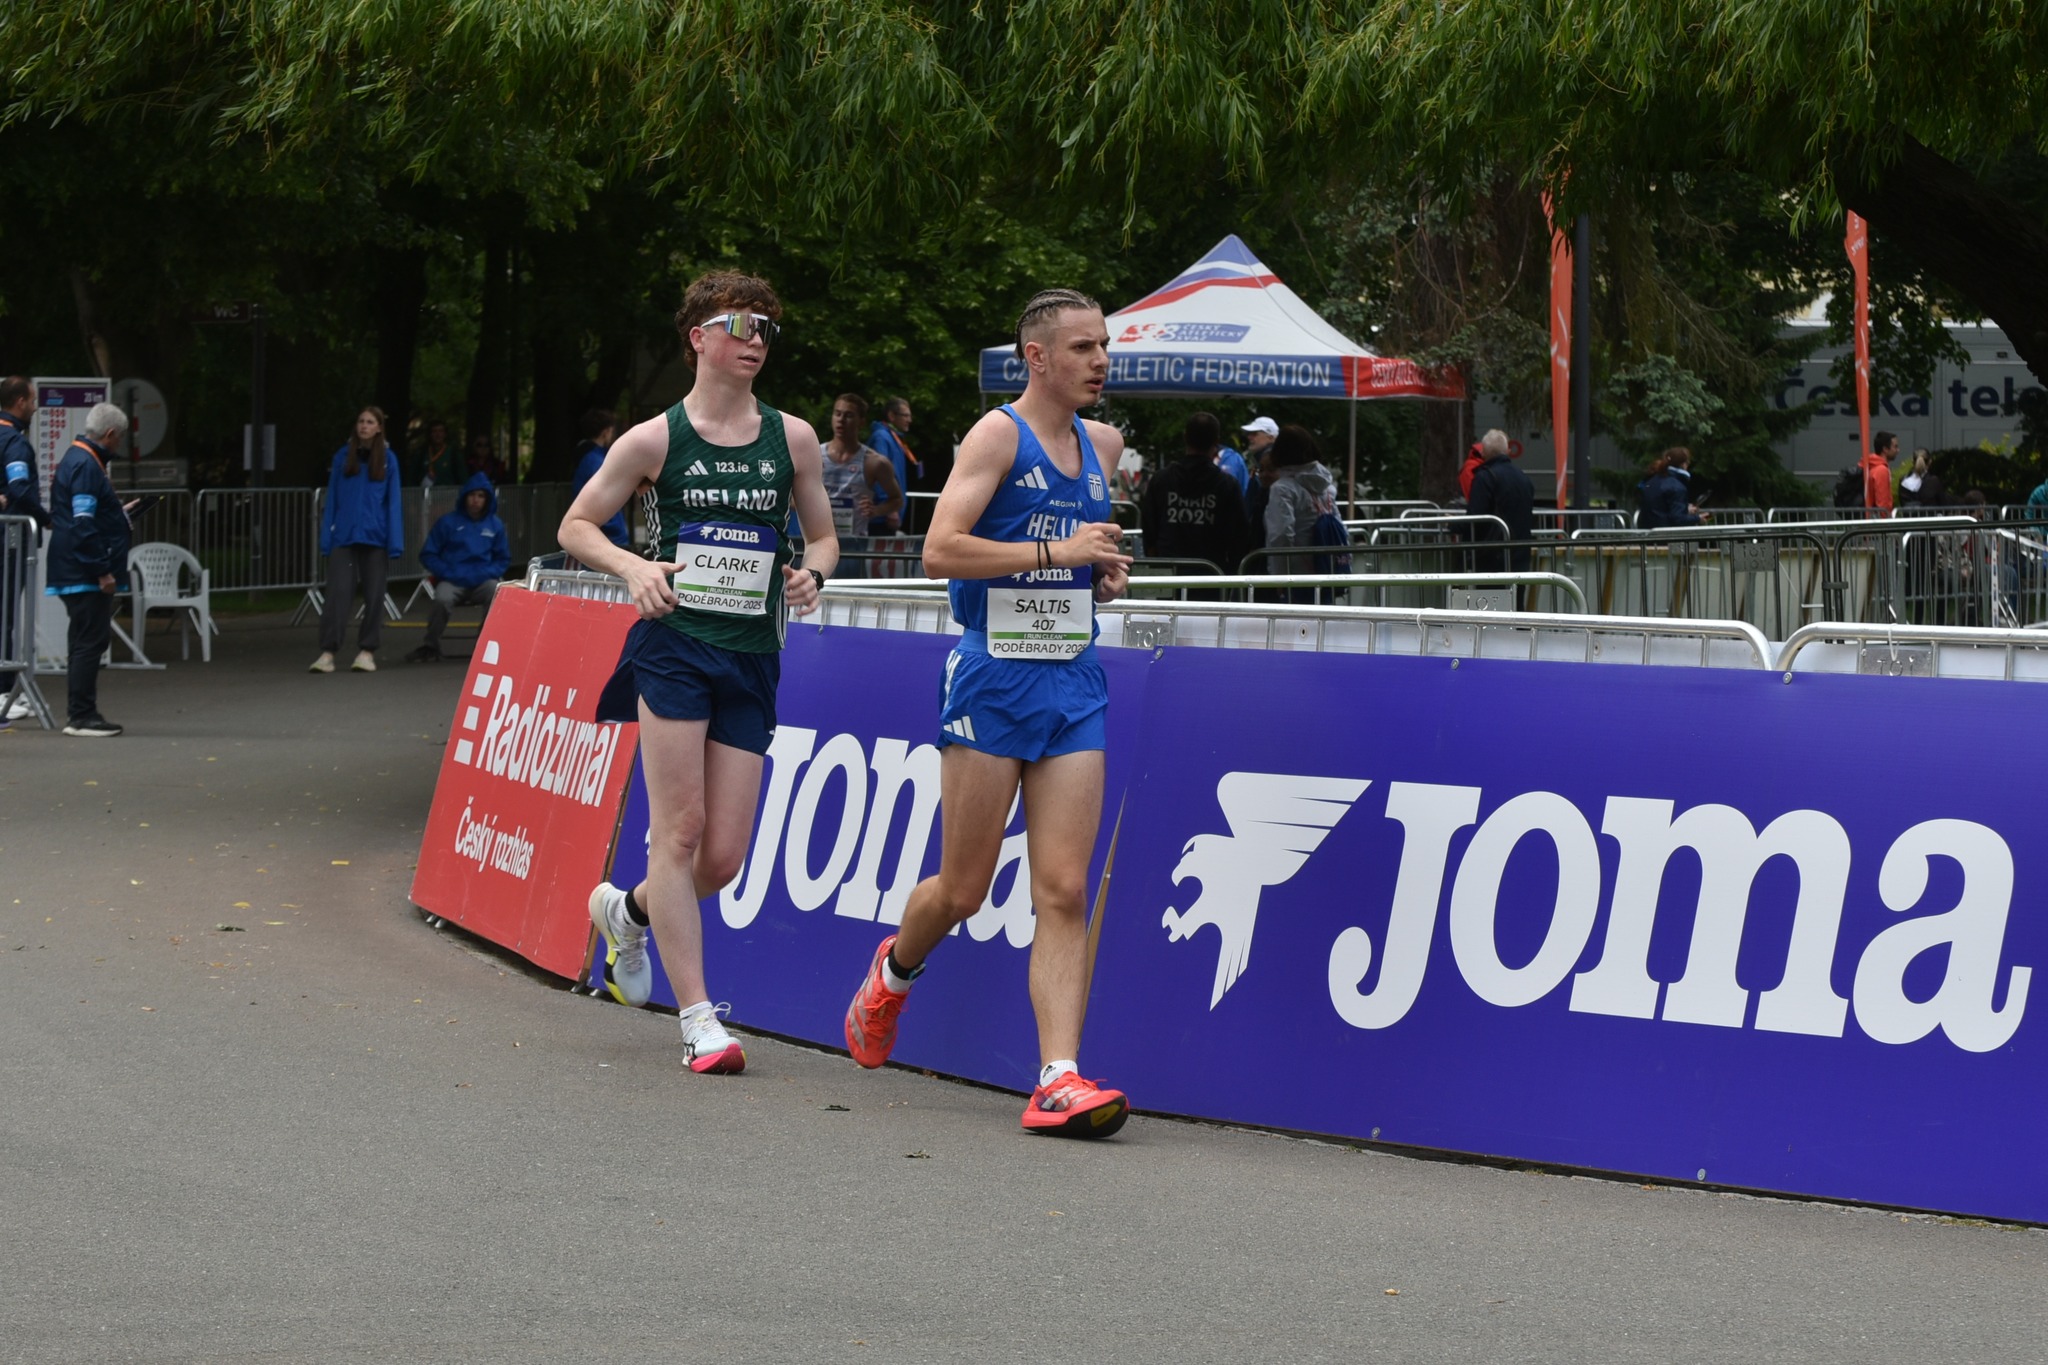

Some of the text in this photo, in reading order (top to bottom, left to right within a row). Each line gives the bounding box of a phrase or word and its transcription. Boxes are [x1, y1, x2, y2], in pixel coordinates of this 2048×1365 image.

[1108, 357, 1331, 388] HLETIC FEDERATION
[715, 461, 749, 473] 123.ie
[683, 488, 778, 511] IRELAND
[1167, 507, 1215, 525] 2024
[1026, 513, 1087, 541] HELLA
[694, 554, 761, 574] CLARKE
[717, 575, 736, 587] 411
[677, 592, 763, 610] PODĚBRADY 2025
[1014, 598, 1072, 614] SALTIS
[1031, 619, 1057, 630] 407
[993, 641, 1064, 654] PODĚBRADY
[454, 796, 535, 881] Český rozhlas
